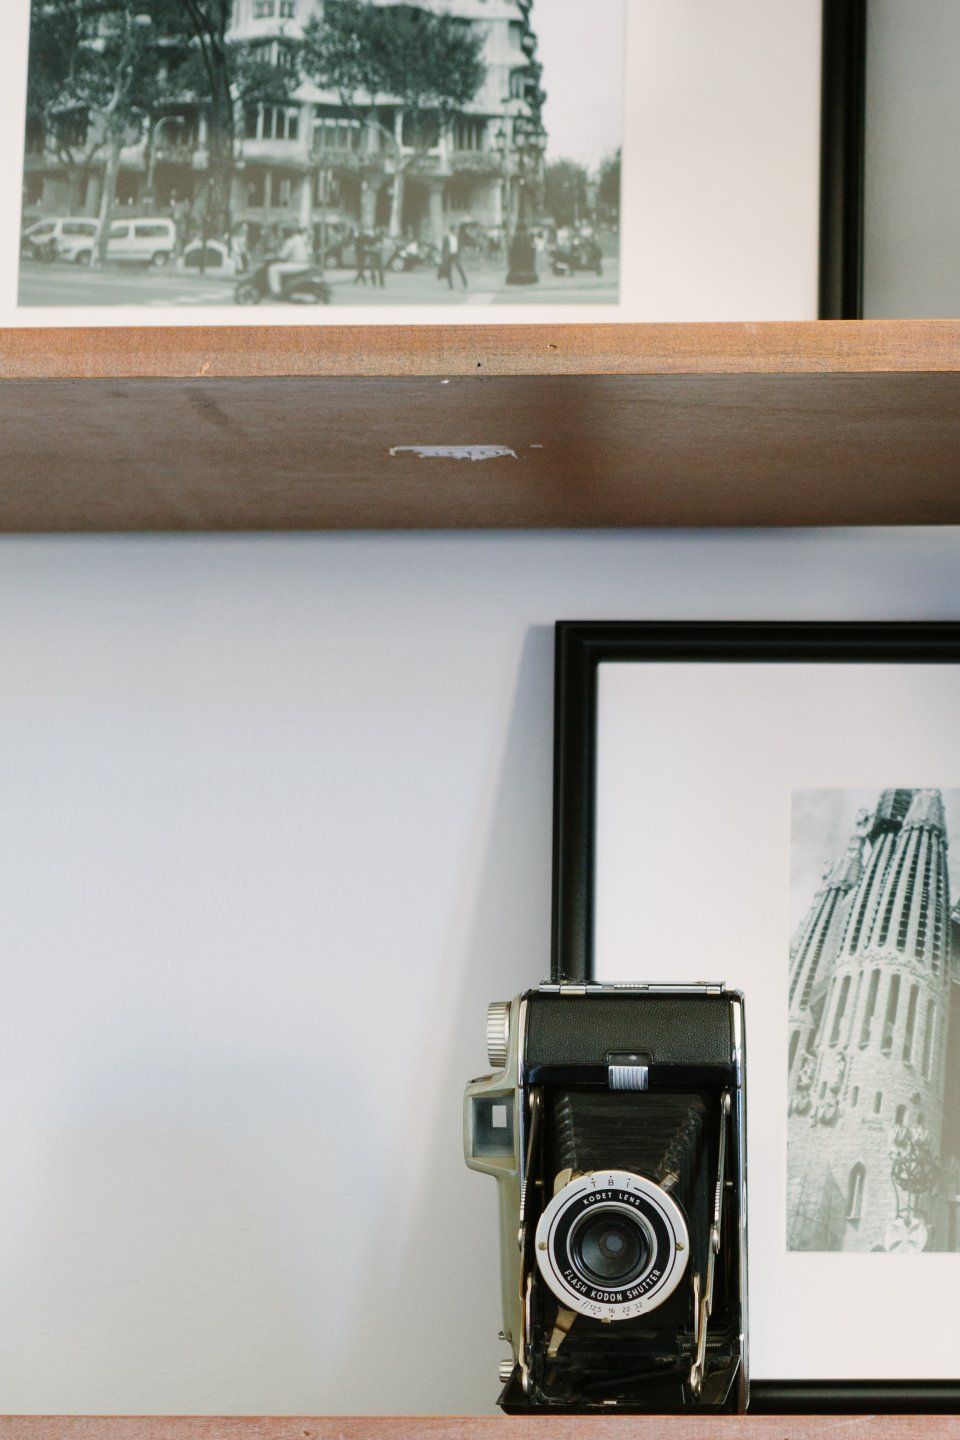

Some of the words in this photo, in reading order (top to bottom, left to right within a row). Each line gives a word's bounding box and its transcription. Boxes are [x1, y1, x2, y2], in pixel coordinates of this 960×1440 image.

[608, 1179, 615, 1187] B
[583, 1192, 612, 1205] KODET
[619, 1193, 640, 1206] LENS
[564, 1269, 588, 1293] FLASH
[590, 1291, 623, 1302] KODON
[627, 1269, 661, 1298] SHUTTER
